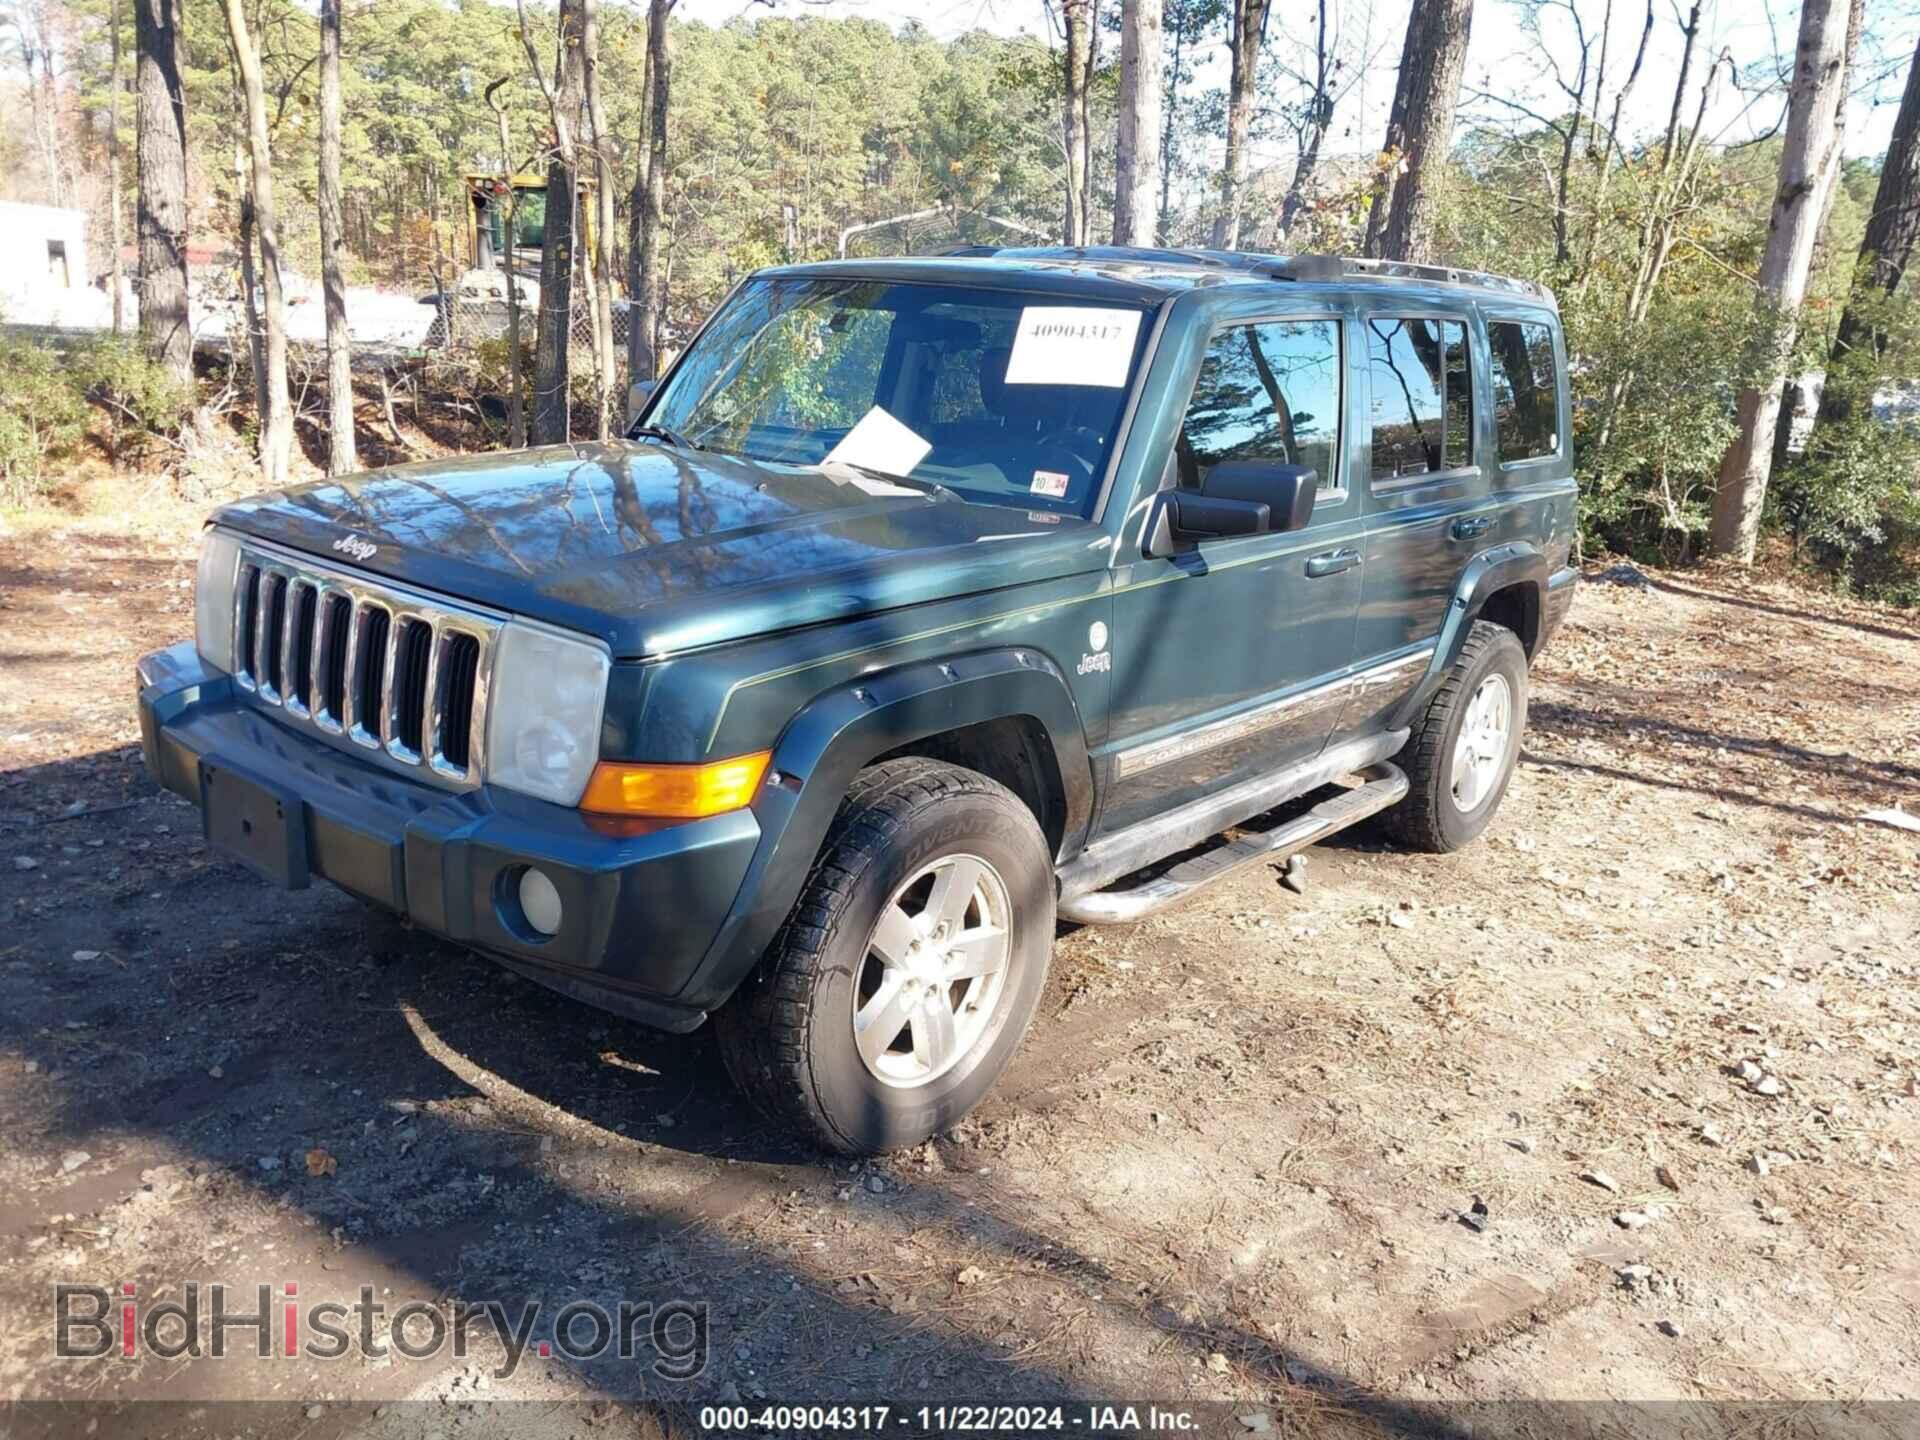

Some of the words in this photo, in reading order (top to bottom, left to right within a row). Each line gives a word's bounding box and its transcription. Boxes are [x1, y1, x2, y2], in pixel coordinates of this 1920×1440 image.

[1029, 323, 1122, 339] 40904317
[332, 533, 378, 561] Jeep
[1076, 651, 1111, 676] Jeep
